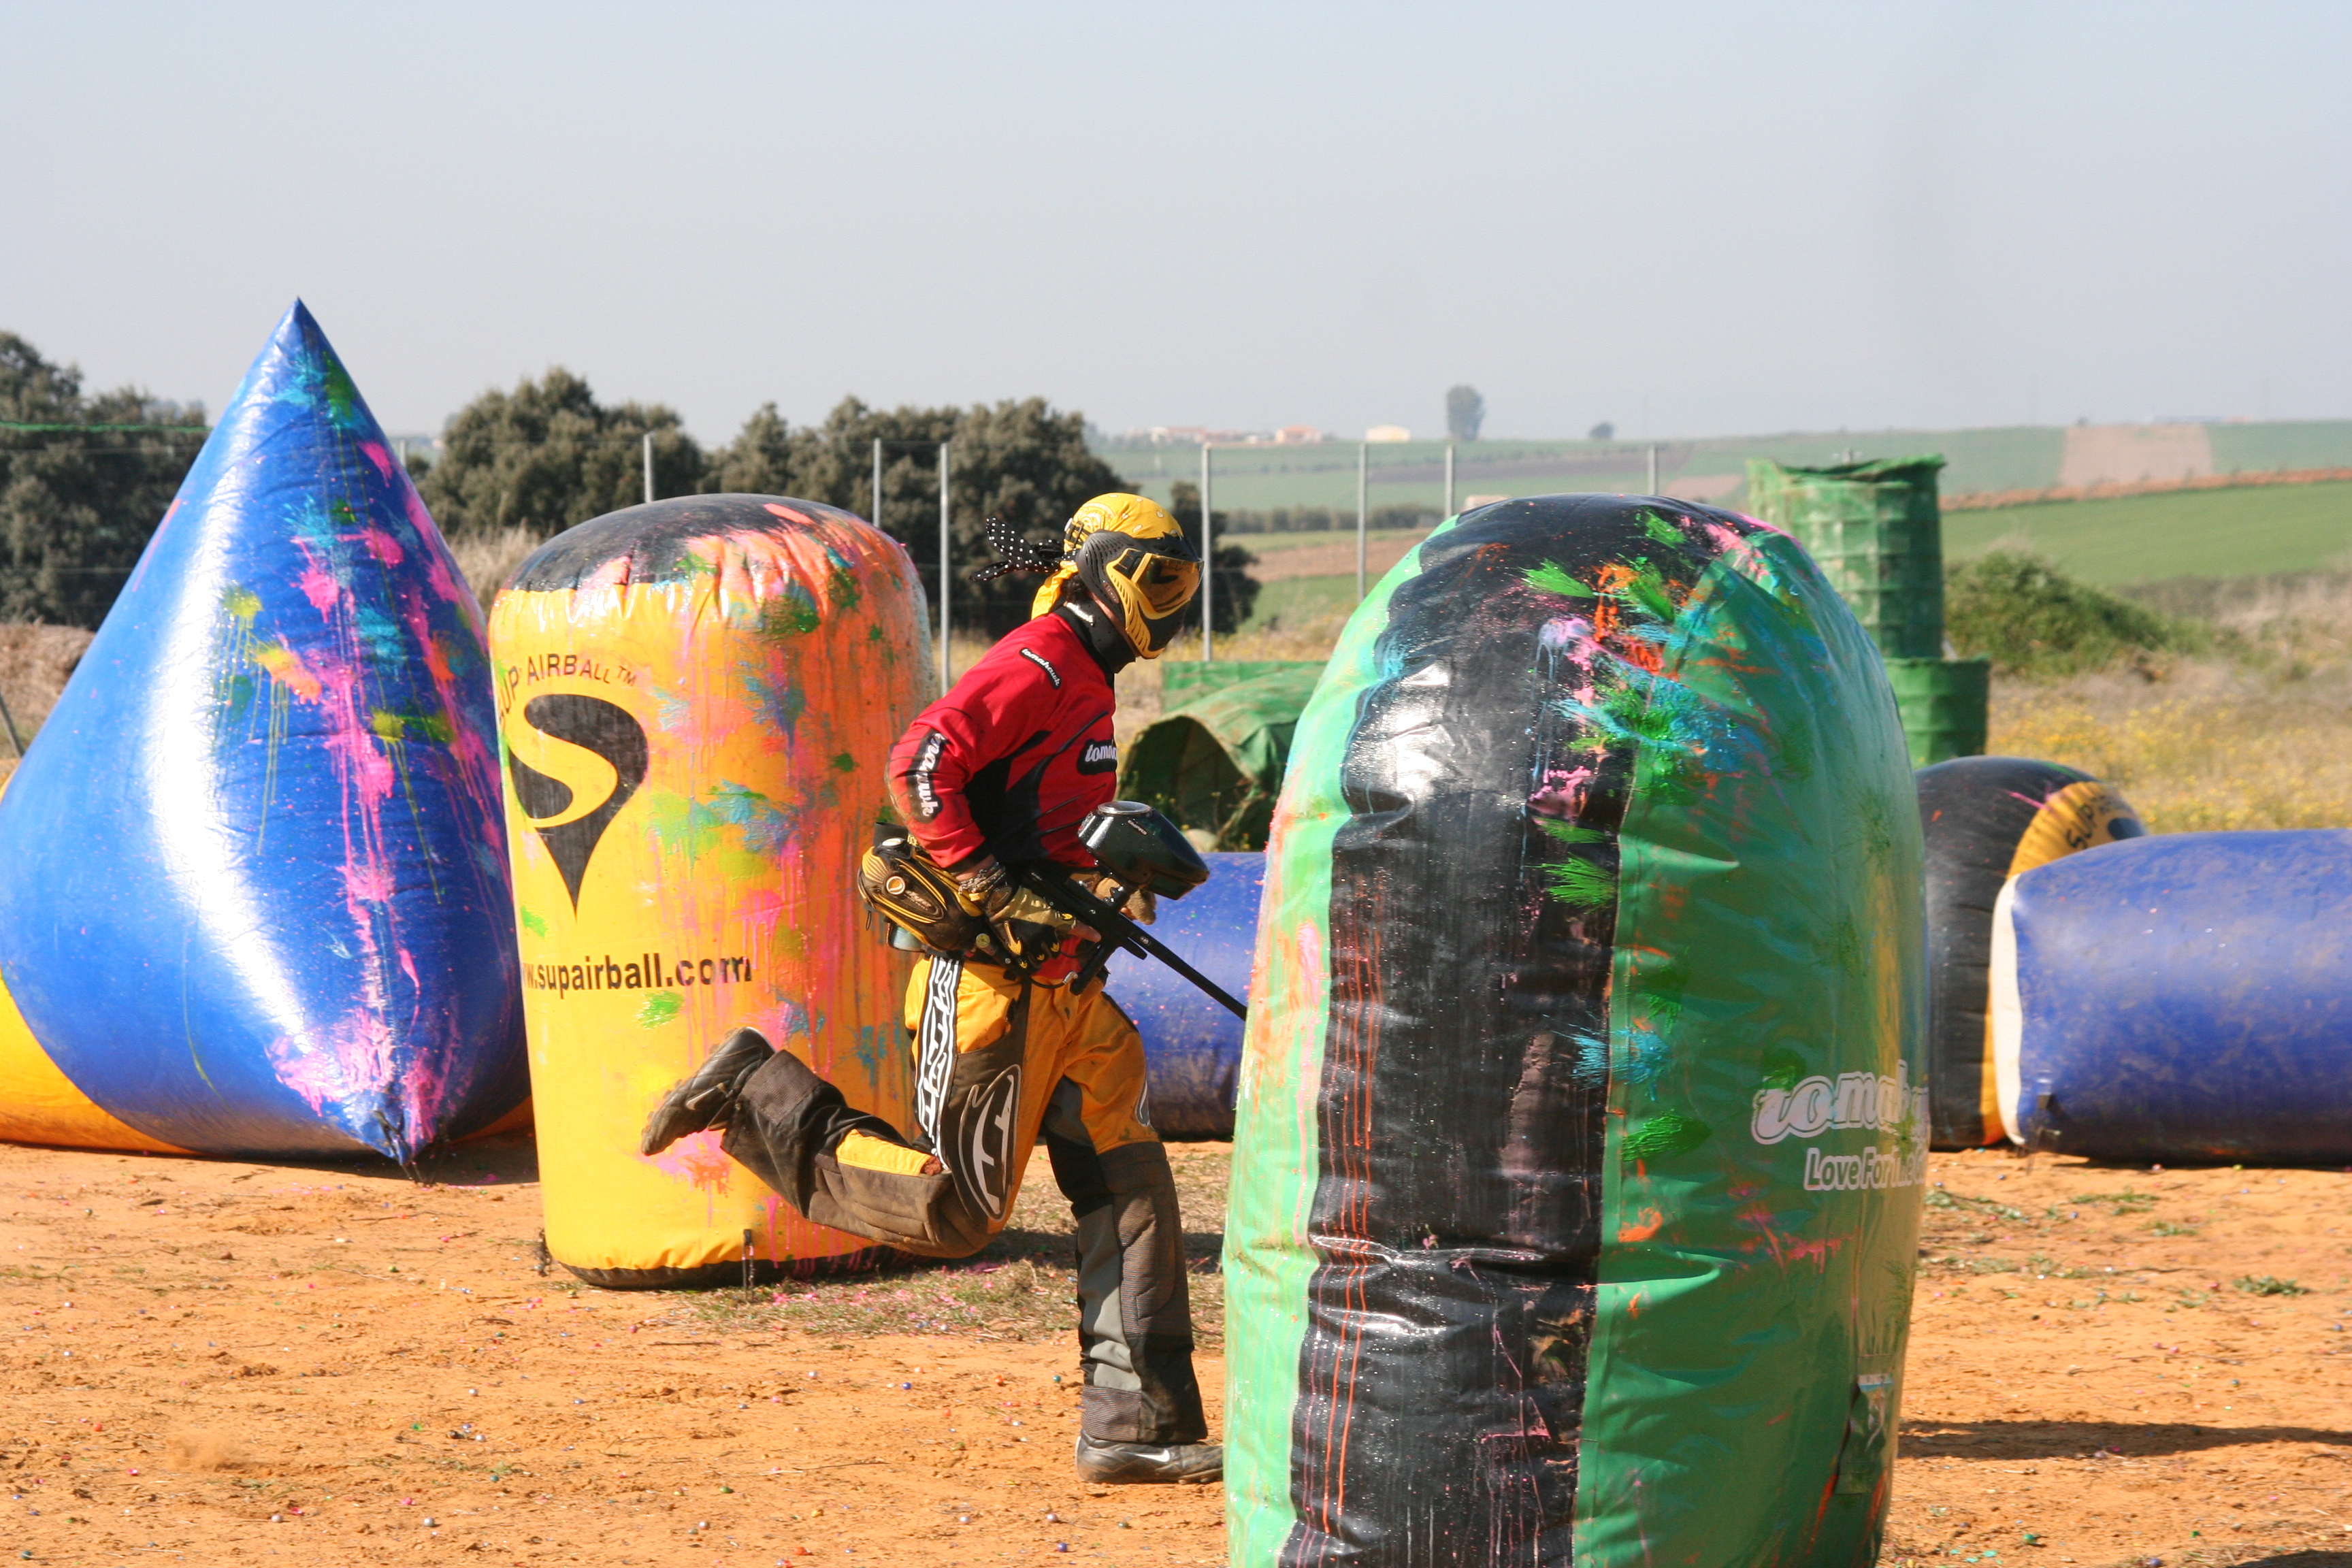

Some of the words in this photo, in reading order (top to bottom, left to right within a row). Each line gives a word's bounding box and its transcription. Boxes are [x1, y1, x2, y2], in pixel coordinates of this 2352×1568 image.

[527, 653, 610, 685] AIRBALL
[1021, 648, 1061, 687] tomahawk
[523, 953, 752, 999] w.supairball.com
